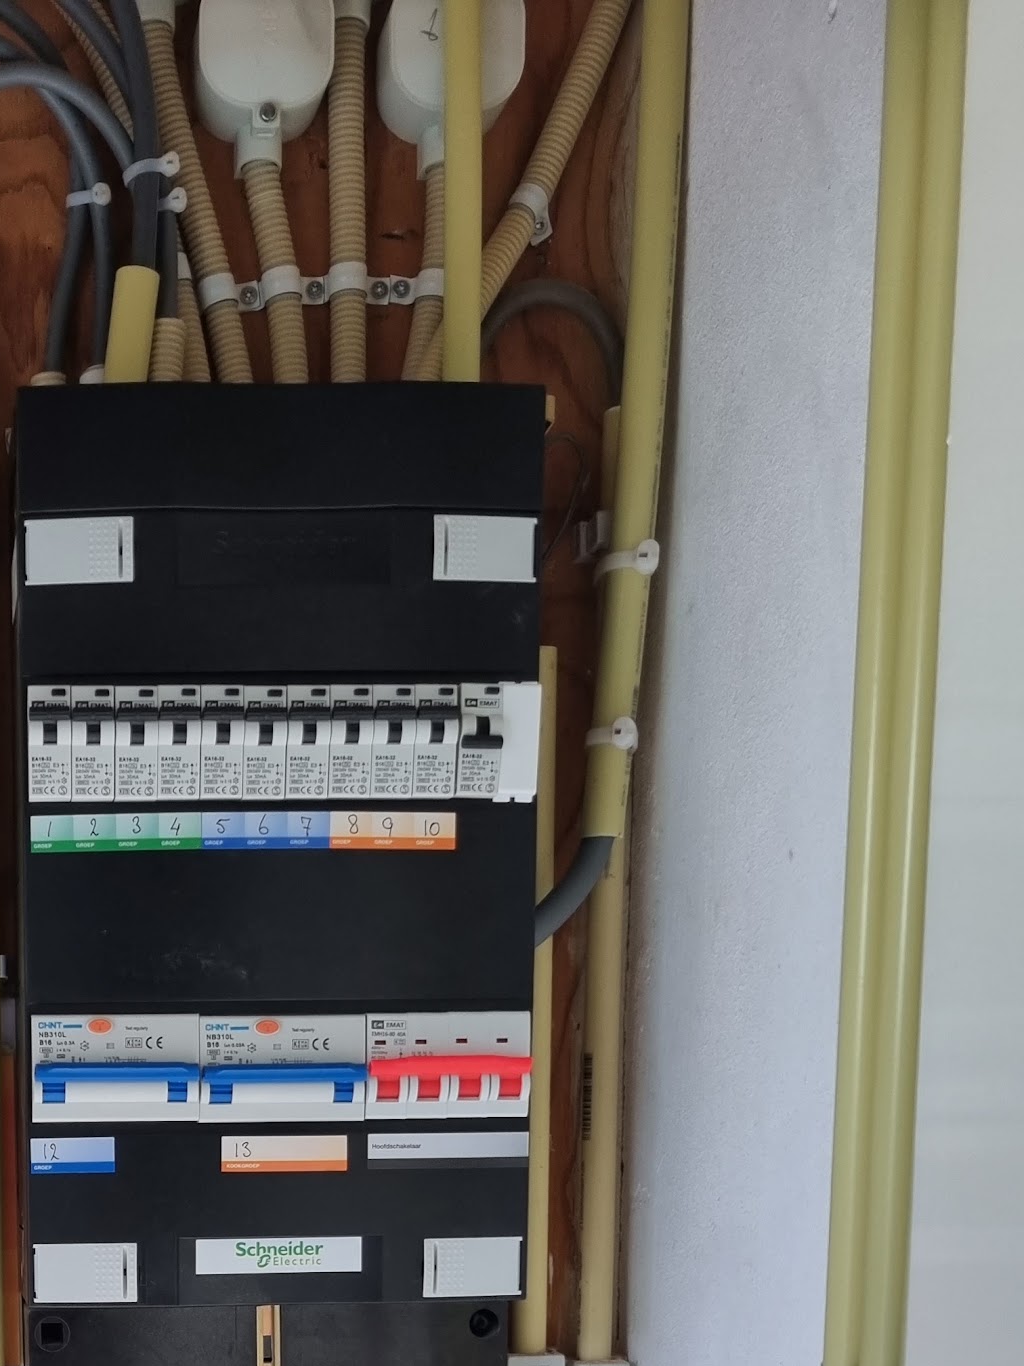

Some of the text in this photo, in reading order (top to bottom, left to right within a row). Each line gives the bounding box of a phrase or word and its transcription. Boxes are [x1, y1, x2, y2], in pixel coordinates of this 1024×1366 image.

[47, 821, 52, 837] 1
[90, 818, 99, 837] 2
[132, 815, 142, 834] 3
[170, 817, 181, 836] 4
[215, 818, 231, 834] 5
[258, 813, 269, 835] 6
[300, 816, 312, 837] 7
[348, 814, 359, 834] 8
[381, 817, 393, 837] 9
[424, 819, 440, 836] 10
[43, 1143, 60, 1161] 12
[235, 1141, 252, 1158] 13
[235, 1241, 323, 1257] Schneider
[273, 1256, 322, 1266] Electric
